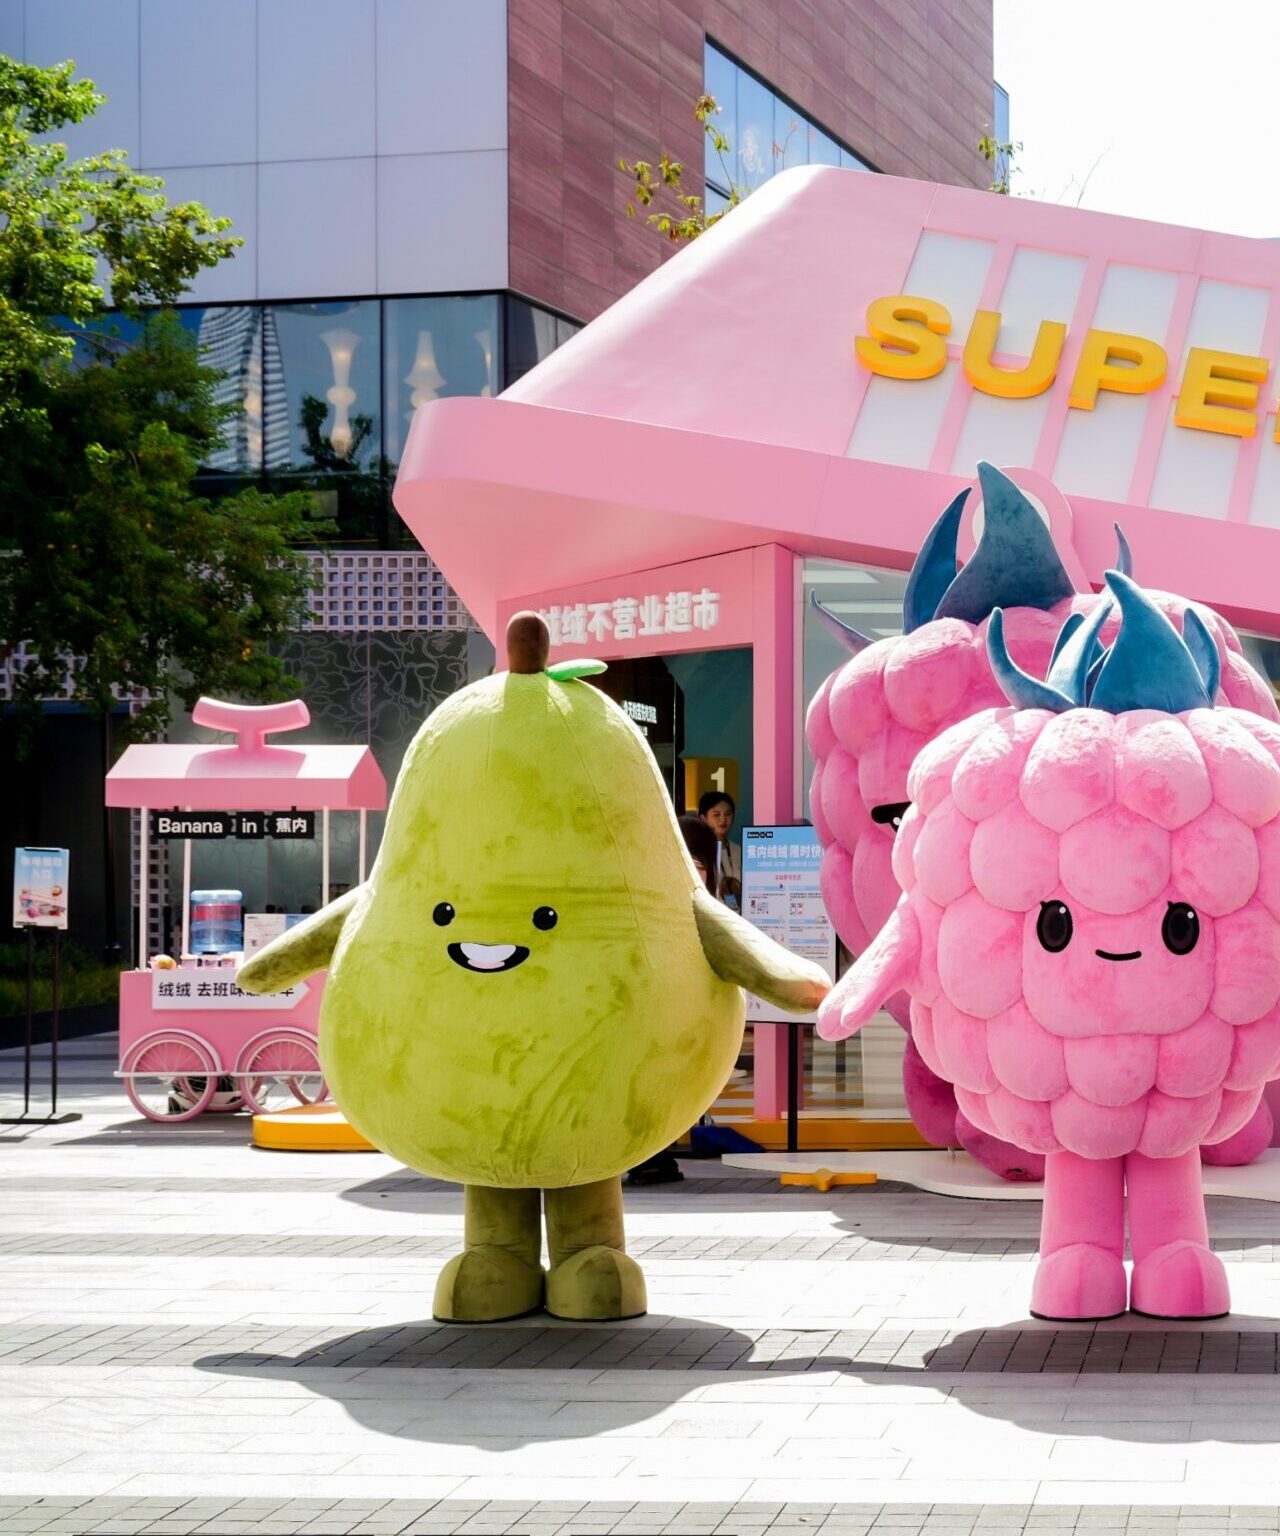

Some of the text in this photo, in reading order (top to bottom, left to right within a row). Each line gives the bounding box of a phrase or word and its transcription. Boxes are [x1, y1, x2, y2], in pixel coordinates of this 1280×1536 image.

[711, 767, 725, 793] 1
[158, 817, 307, 834] Banana in 蕉内
[158, 982, 294, 997] 绒绒 去班味
